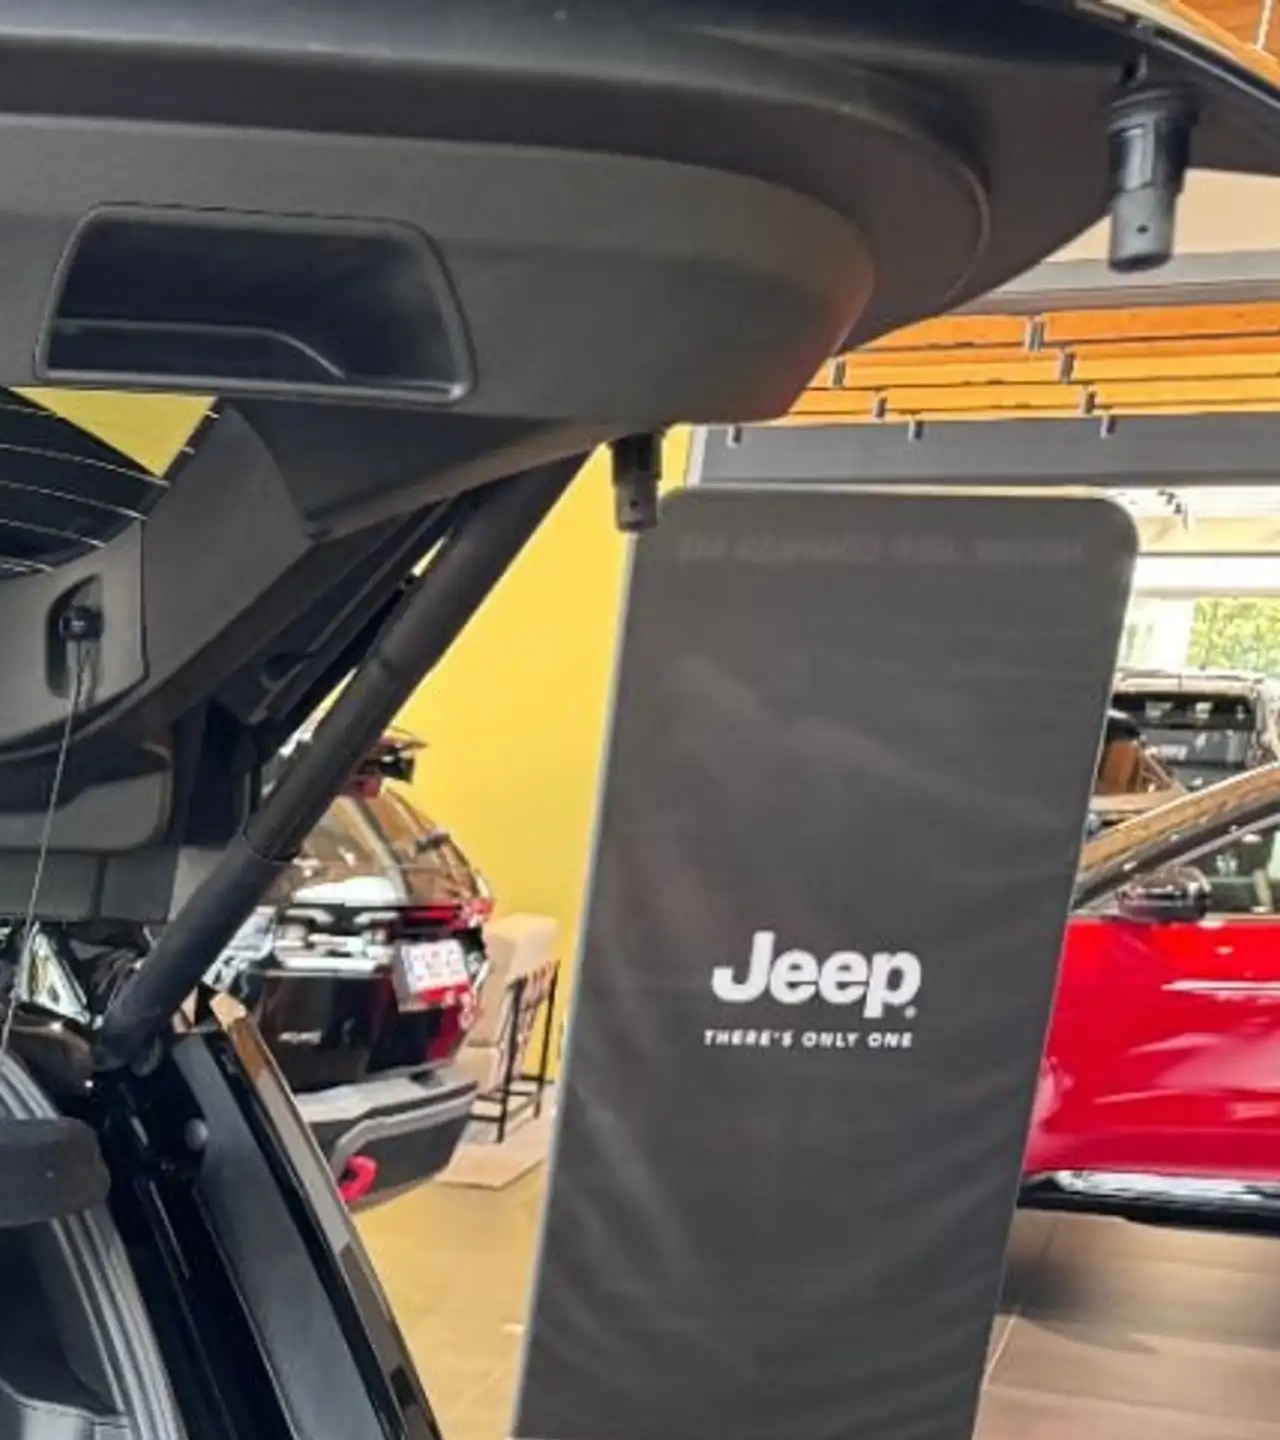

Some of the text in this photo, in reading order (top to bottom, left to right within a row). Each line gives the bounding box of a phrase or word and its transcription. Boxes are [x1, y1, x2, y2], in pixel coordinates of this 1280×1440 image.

[711, 930, 922, 1018] Jeep
[703, 1028, 913, 1049] THERE'S ONLY ONE
